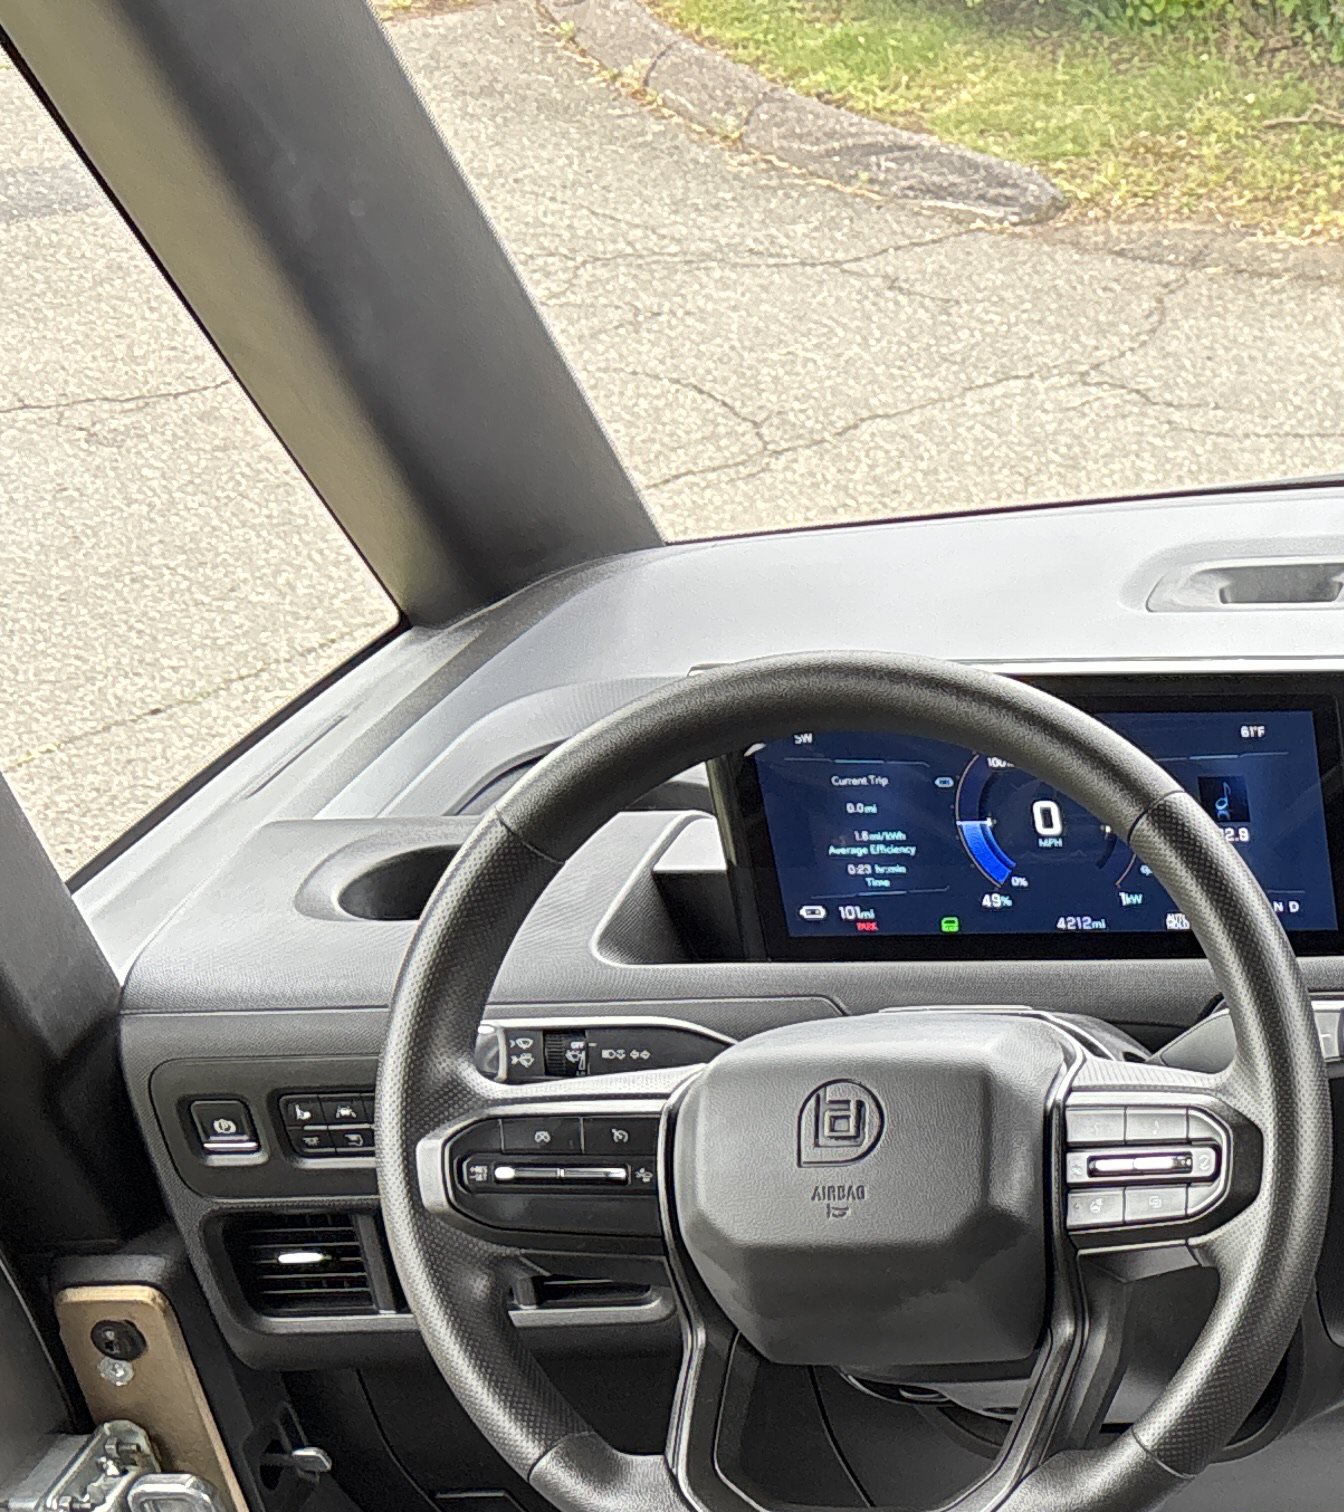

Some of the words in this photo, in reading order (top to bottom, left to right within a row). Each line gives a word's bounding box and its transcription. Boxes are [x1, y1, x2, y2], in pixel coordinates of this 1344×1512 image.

[831, 774, 867, 787] Current
[867, 774, 890, 788] Trip
[1032, 800, 1063, 836] 0
[1038, 838, 1063, 848] MPH
[828, 844, 868, 857] Average
[869, 843, 917, 857] Efficiency
[865, 877, 891, 888] Time
[1011, 876, 1029, 888] 0%
[981, 892, 1013, 908] 49%
[1288, 900, 1300, 913] D
[856, 920, 879, 932] PARK
[810, 1184, 867, 1203] AIRBAG
